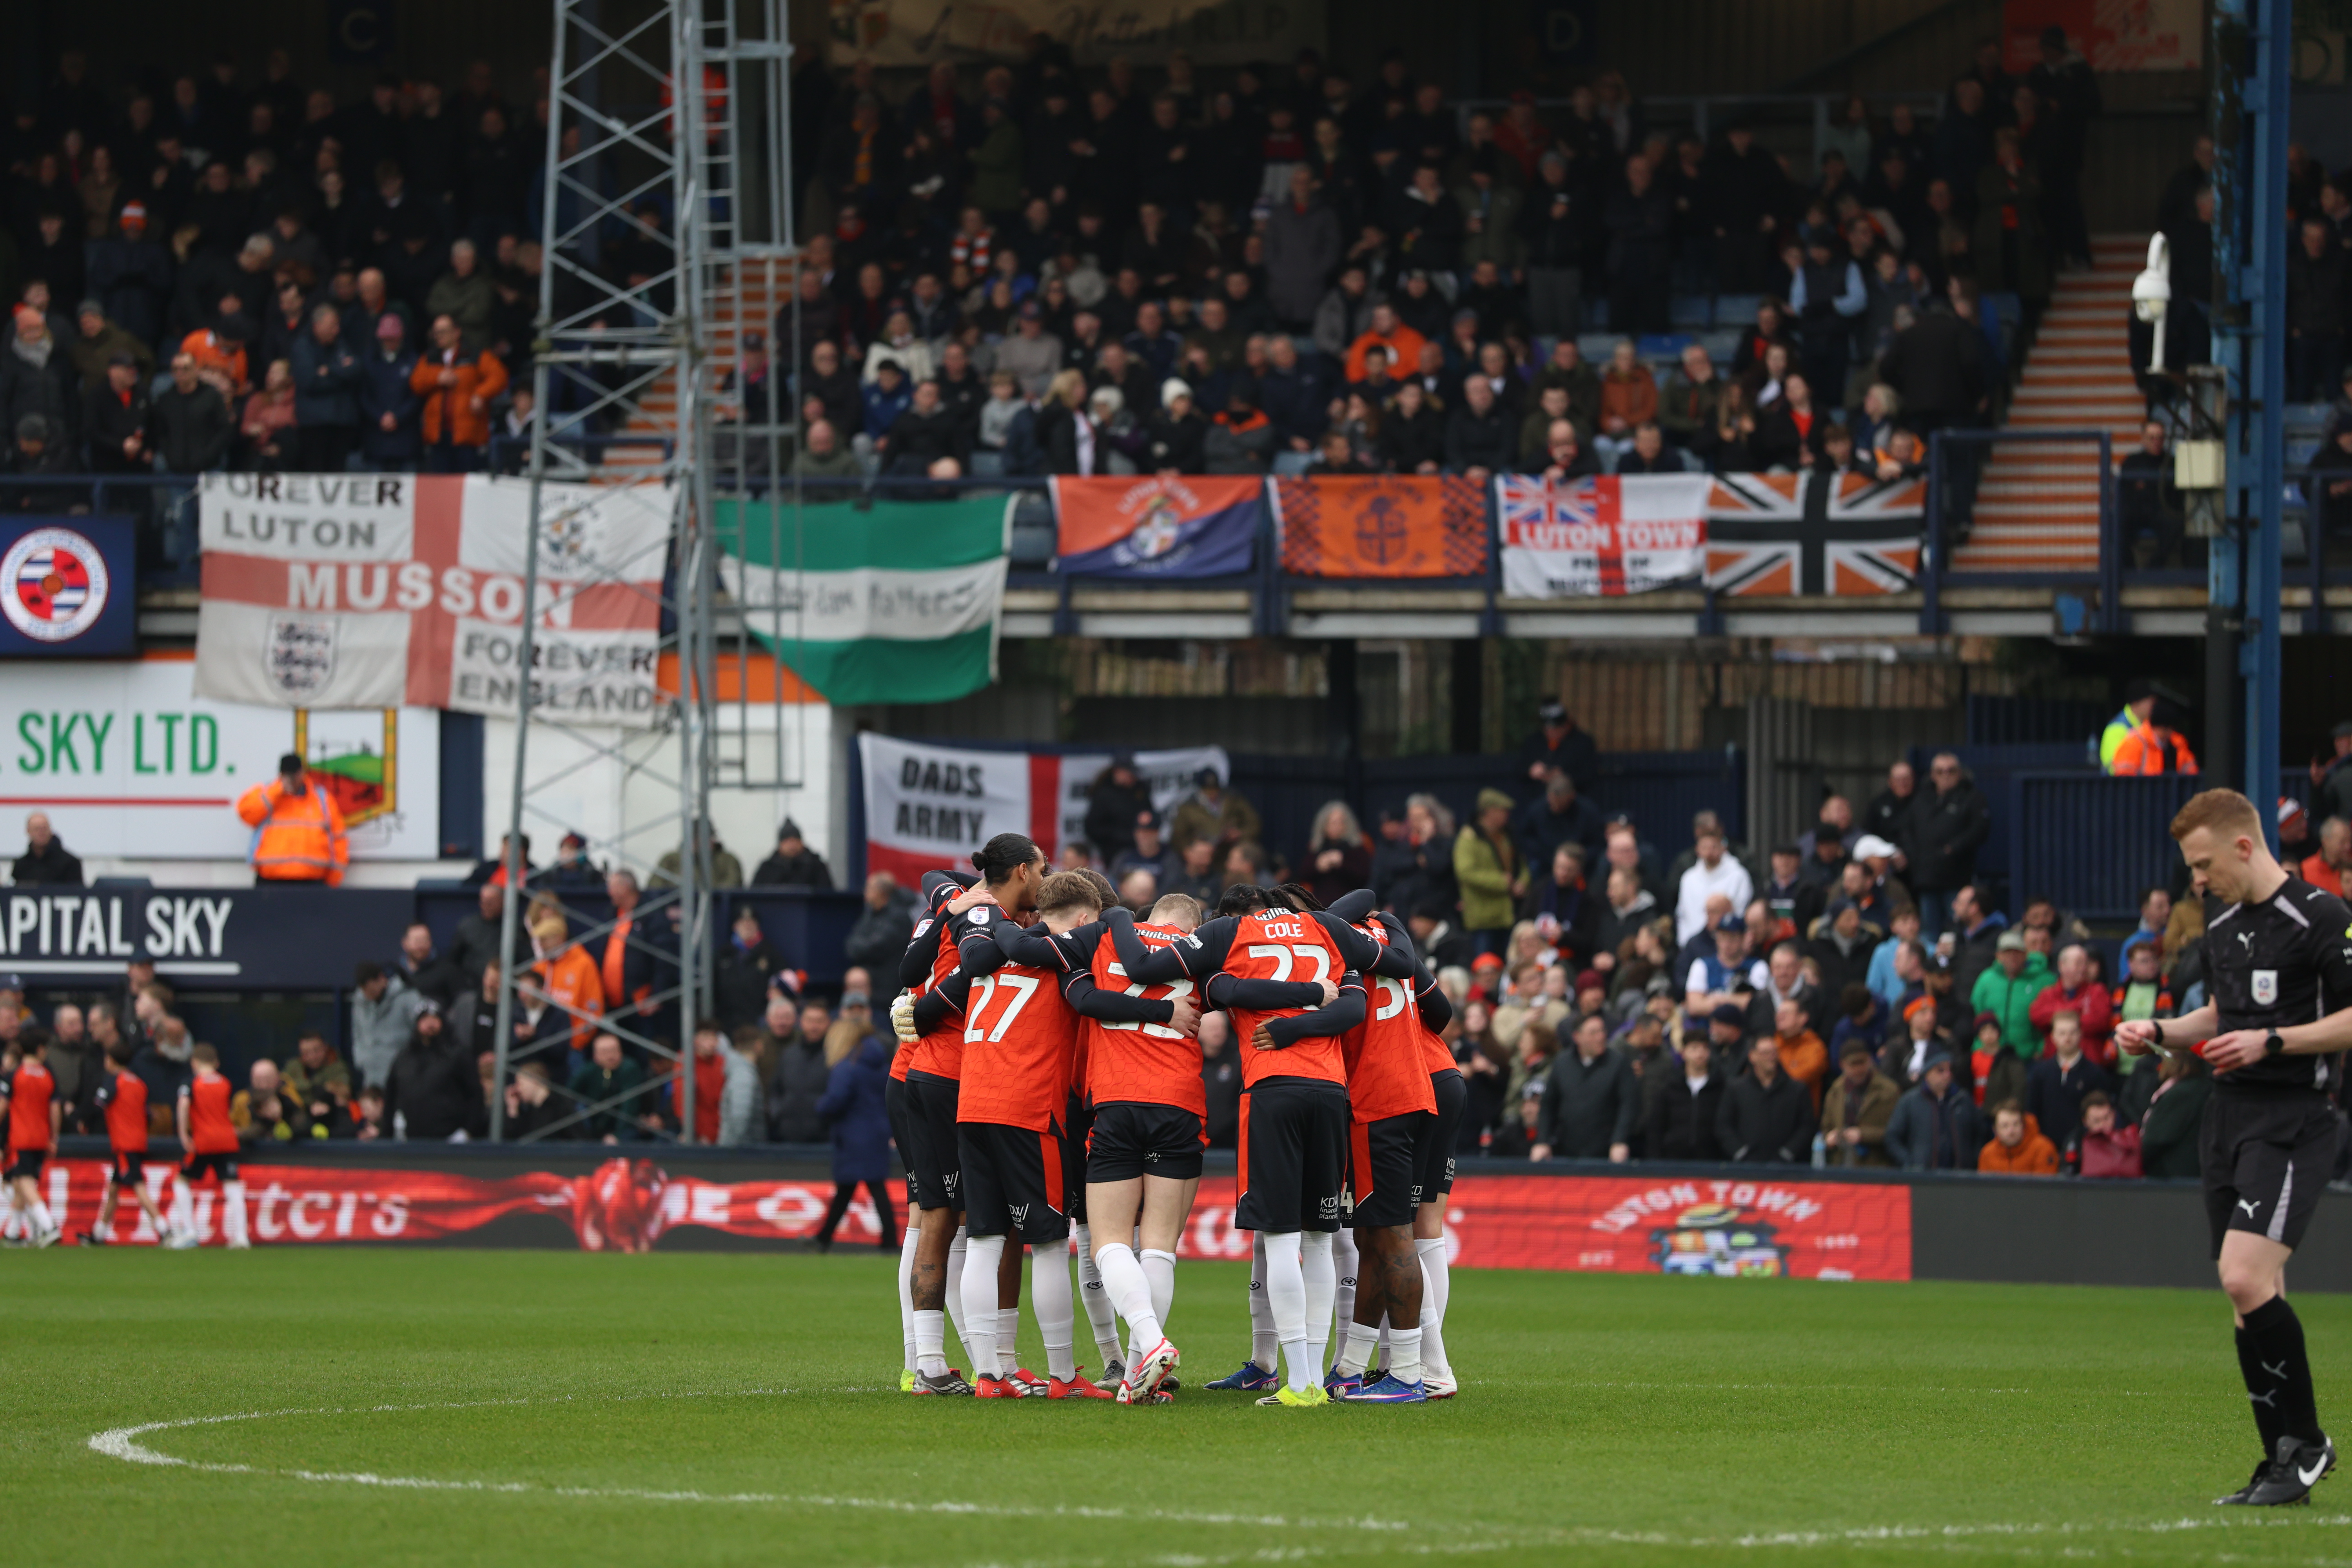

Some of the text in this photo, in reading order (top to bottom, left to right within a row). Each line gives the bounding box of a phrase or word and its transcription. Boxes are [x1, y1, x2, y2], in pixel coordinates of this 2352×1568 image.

[340, 8, 379, 52] C
[1546, 9, 1581, 51] D
[223, 511, 376, 548] LUTON
[1518, 523, 1697, 550] LUTON TOWN
[287, 561, 576, 628] MUSSON
[18, 712, 235, 775] SKY LTD.
[902, 757, 984, 798] DADS
[896, 802, 984, 845] ARMY
[0, 896, 233, 956] PITAL SKY
[1264, 922, 1304, 939] COLE
[964, 974, 1040, 1044] 27
[1340, 1181, 1354, 1213] 4
[1709, 1179, 1822, 1222] TOWN
